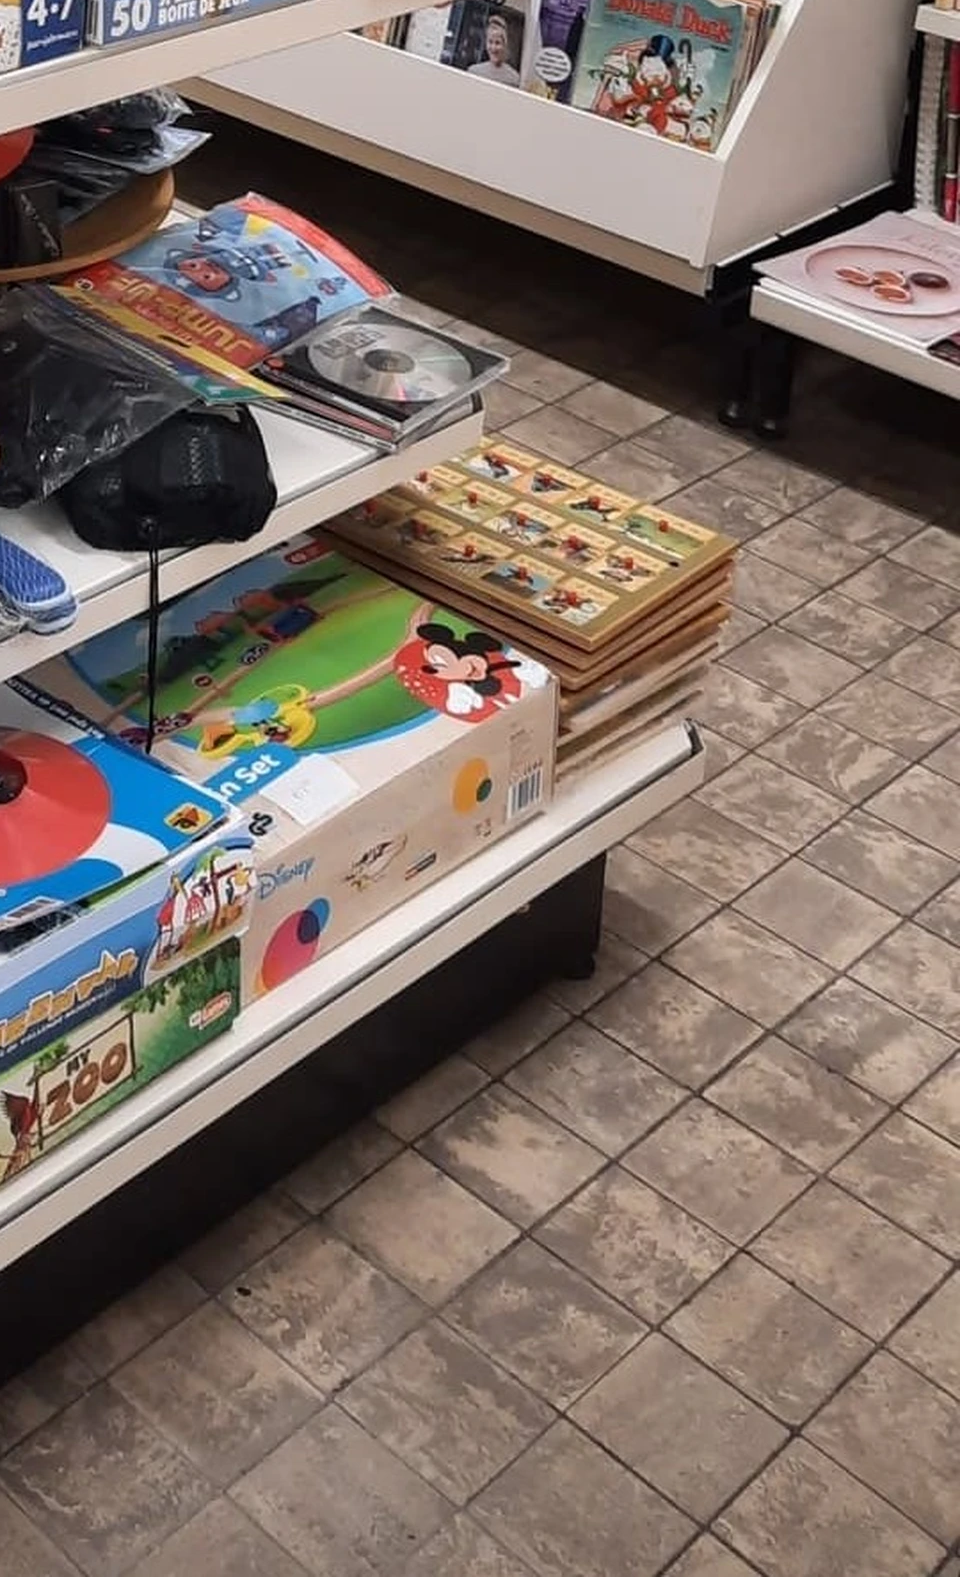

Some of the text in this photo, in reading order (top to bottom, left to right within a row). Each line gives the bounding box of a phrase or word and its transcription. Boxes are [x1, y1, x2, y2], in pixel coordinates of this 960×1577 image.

[243, 751, 283, 787] Set
[66, 1047, 91, 1076] MY
[47, 1042, 128, 1126] ZOO
